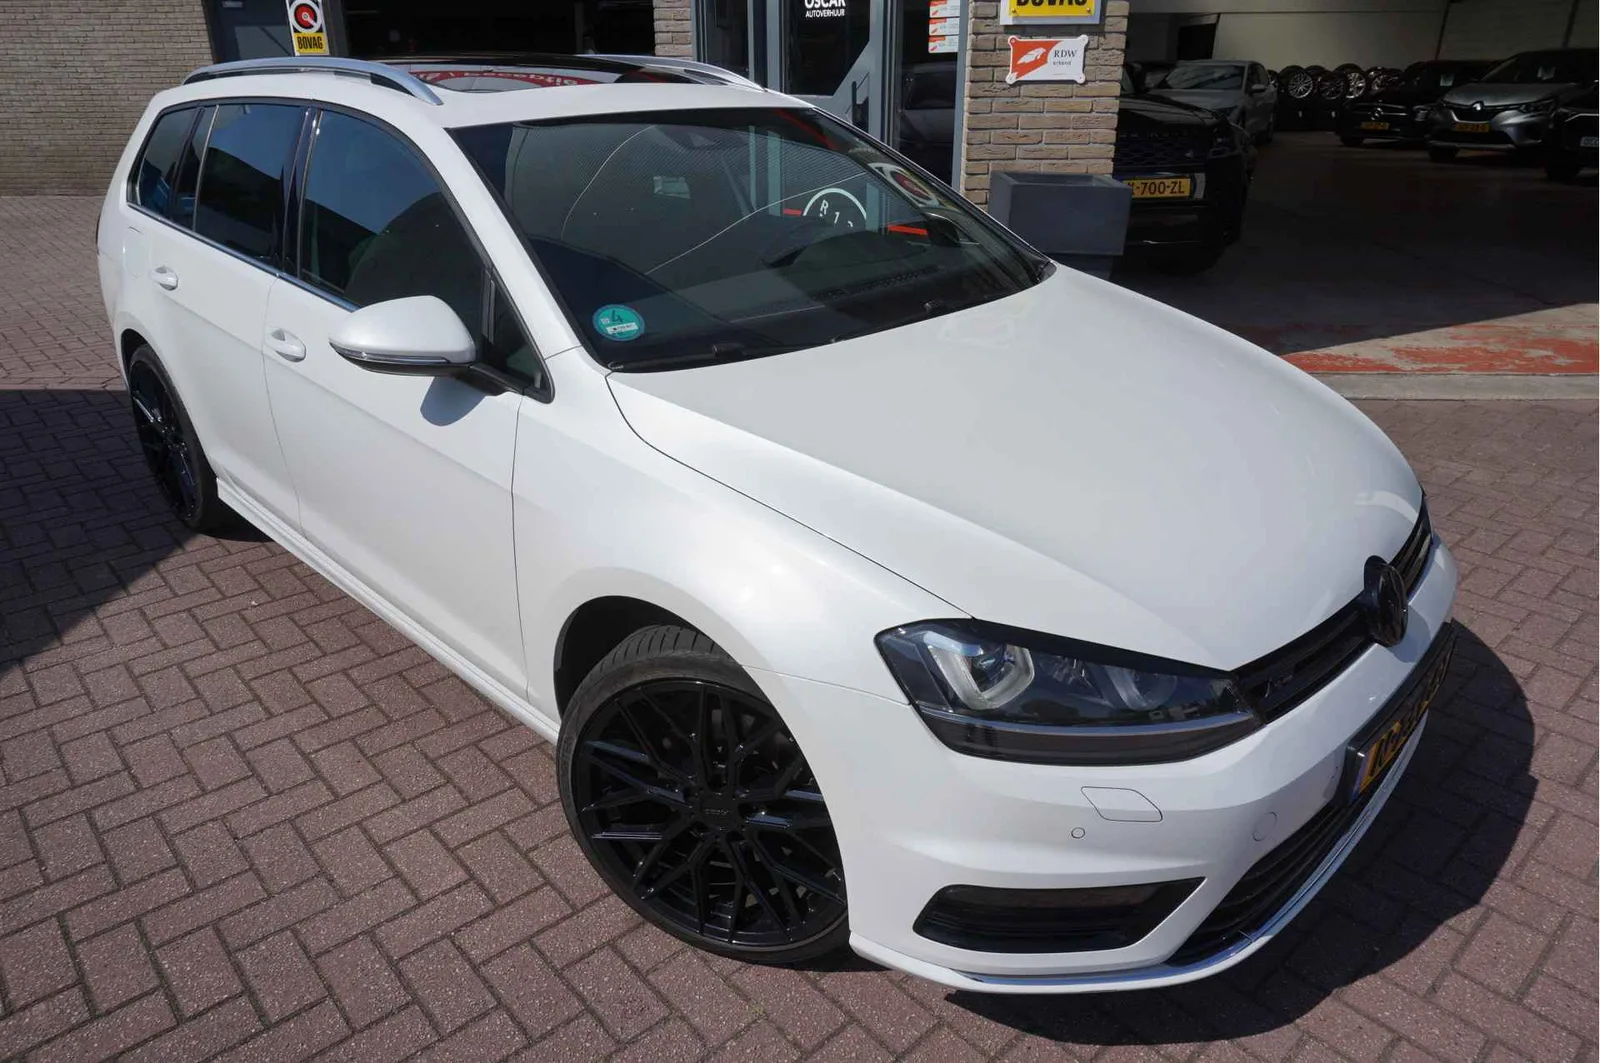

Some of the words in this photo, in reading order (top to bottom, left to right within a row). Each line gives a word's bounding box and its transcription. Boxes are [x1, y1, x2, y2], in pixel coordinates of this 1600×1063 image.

[805, 9, 845, 18] AUTOVERHUUR
[297, 36, 324, 50] BOVAG
[1053, 50, 1077, 58] RDW
